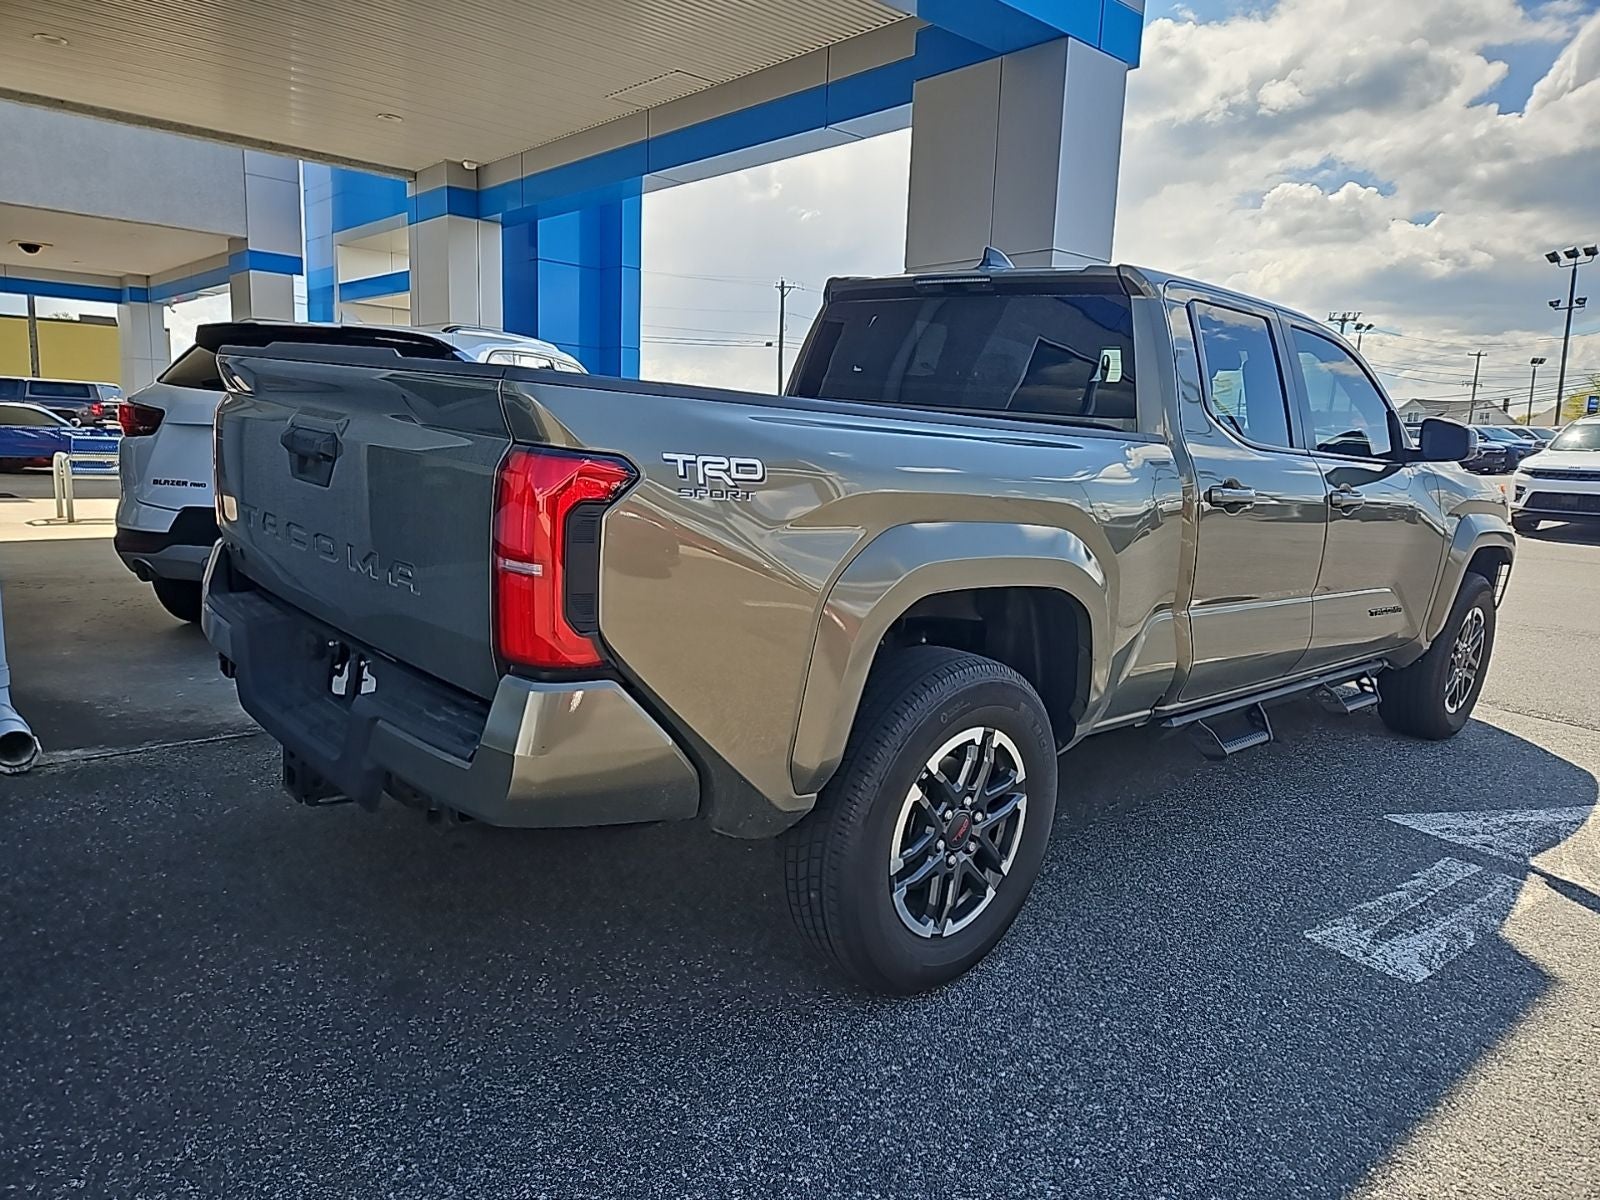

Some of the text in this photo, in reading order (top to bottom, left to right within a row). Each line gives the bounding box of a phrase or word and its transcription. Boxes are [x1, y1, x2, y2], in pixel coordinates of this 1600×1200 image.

[662, 452, 766, 488] TRD
[152, 479, 188, 487] BLAZER
[678, 488, 756, 501] SPORT
[240, 502, 422, 597] TACOMA
